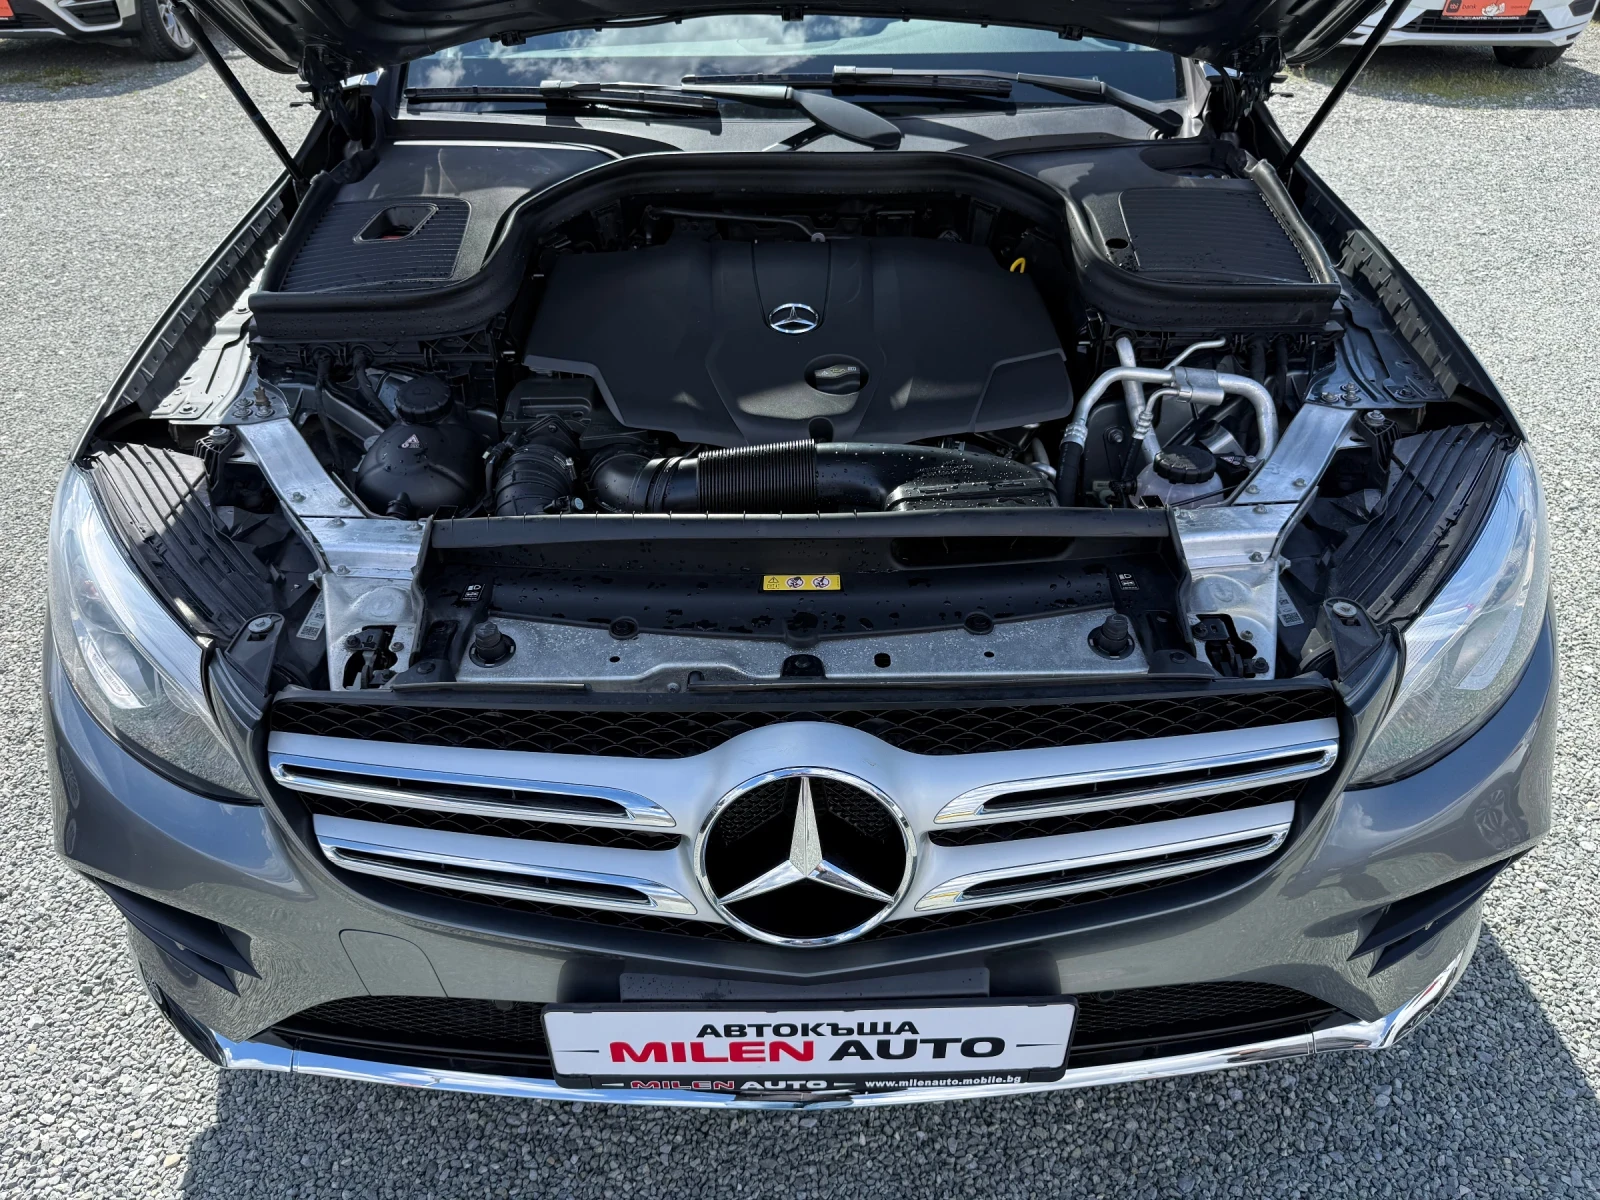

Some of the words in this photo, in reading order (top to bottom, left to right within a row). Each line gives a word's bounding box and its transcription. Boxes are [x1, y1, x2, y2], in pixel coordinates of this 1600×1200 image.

[609, 1040, 815, 1063] MILEN
[828, 1036, 1006, 1062] AUTO
[630, 1080, 735, 1090] MILEN
[740, 1080, 828, 1090] AUTO
[864, 1075, 1022, 1089] www.milenauto.mobile.bg
